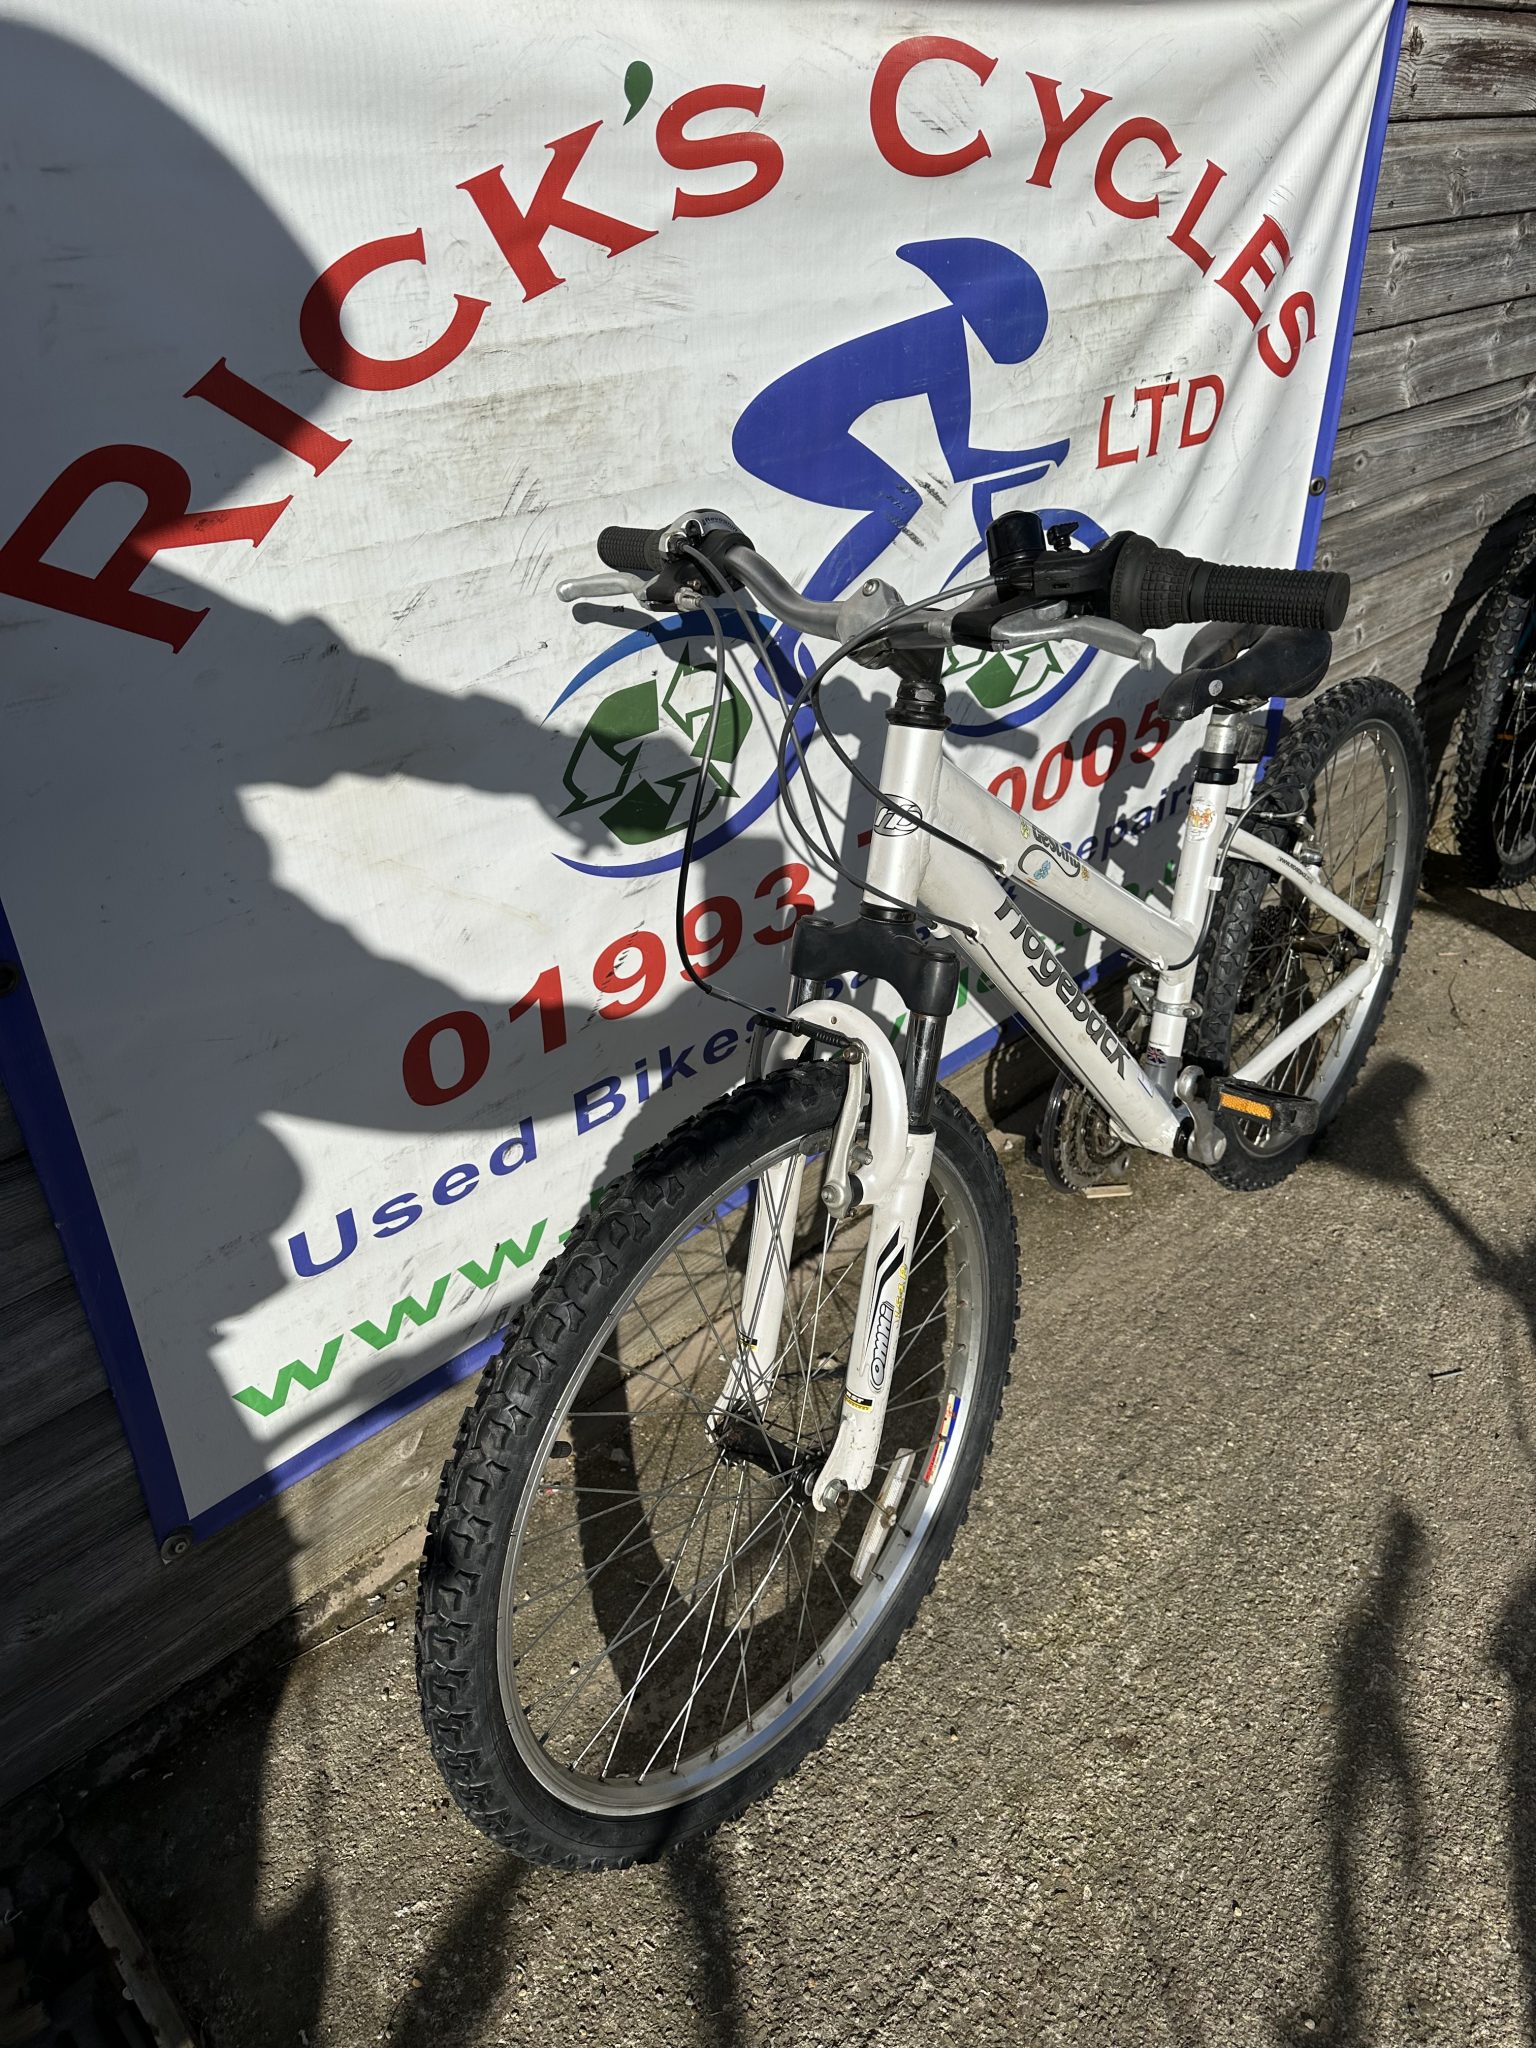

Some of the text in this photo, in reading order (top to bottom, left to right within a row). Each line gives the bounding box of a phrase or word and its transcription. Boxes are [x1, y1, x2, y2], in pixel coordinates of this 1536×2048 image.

[0, 35, 1317, 655] RICK'S CYCLES
[1096, 374, 1225, 469] LTD
[288, 1117, 538, 1278] Used
[1062, 781, 1195, 862] epair
[402, 863, 815, 1107] 01993
